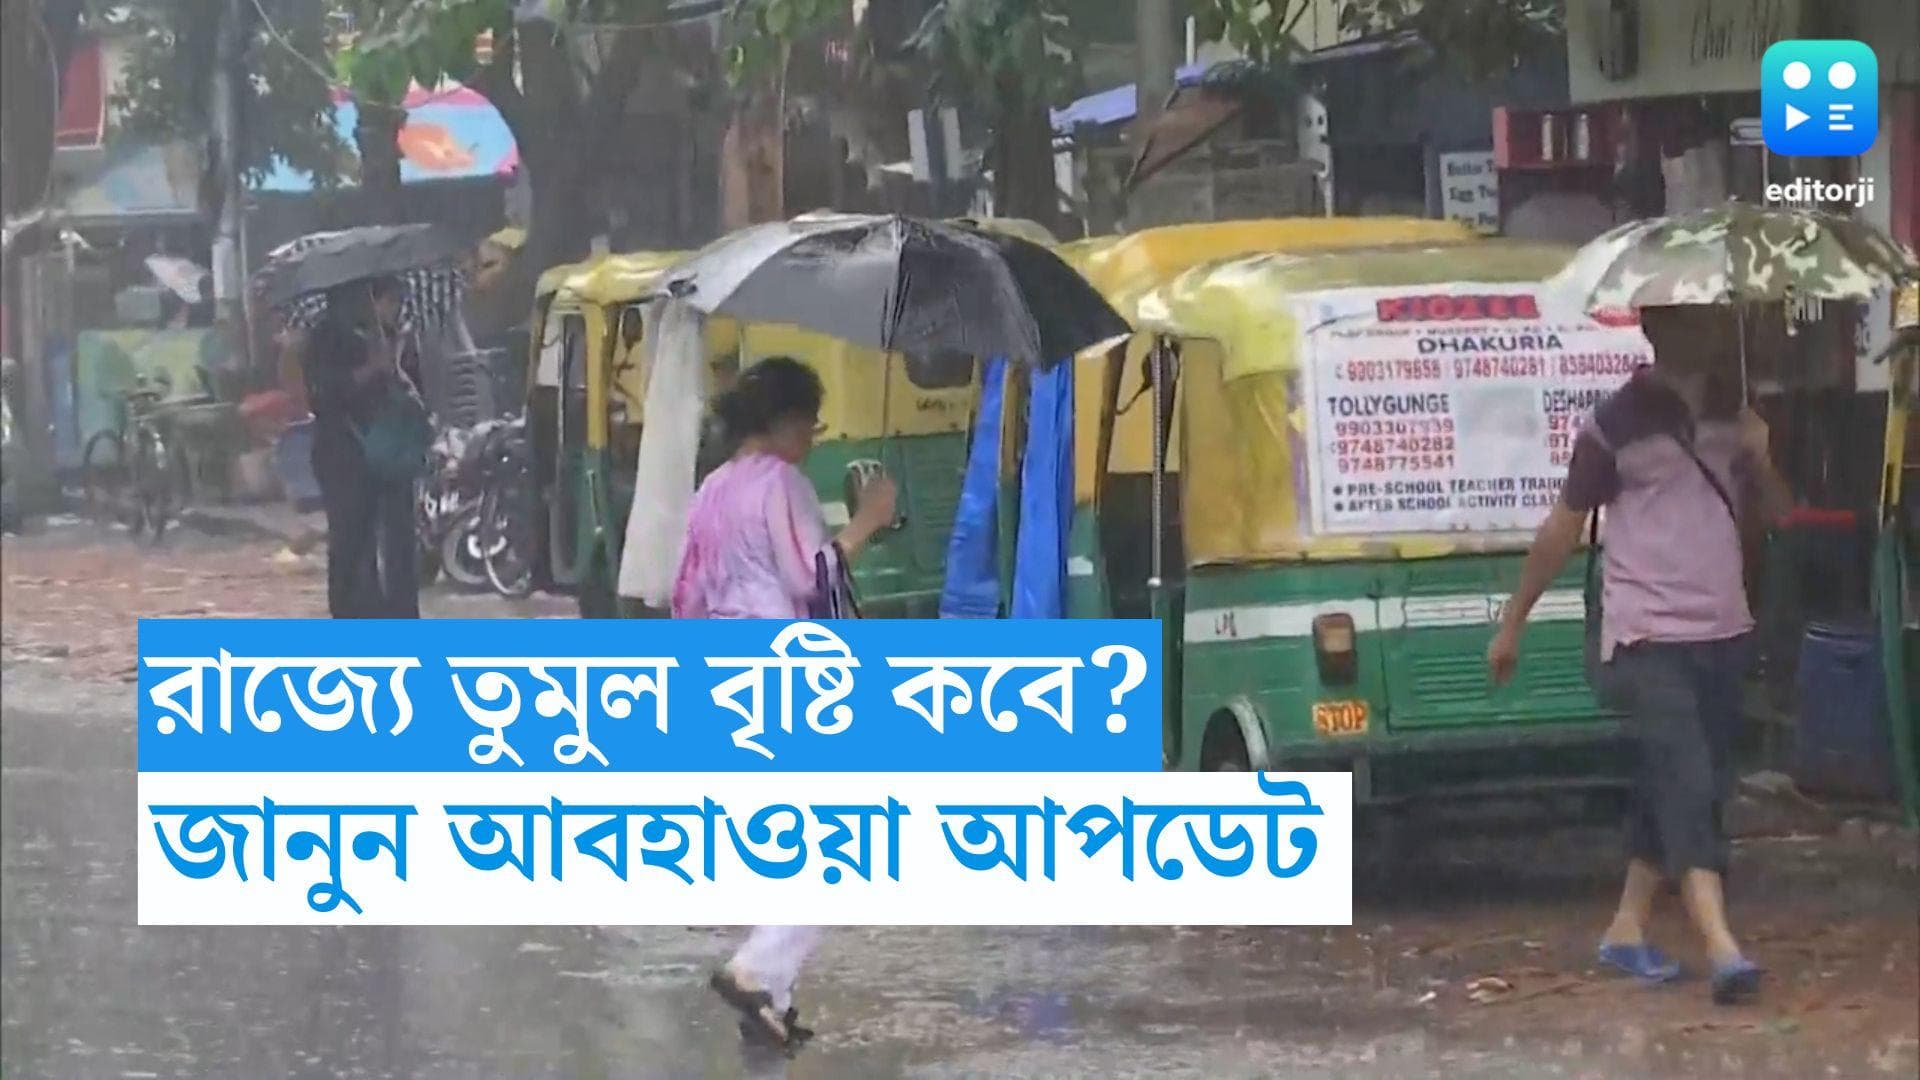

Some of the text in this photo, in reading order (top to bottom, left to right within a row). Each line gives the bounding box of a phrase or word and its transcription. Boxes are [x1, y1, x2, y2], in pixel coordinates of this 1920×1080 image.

[1417, 334, 1564, 354] DHAKURIA
[1328, 394, 1450, 416] TOLLYGUNGE
[1317, 705, 1364, 731] STOP
